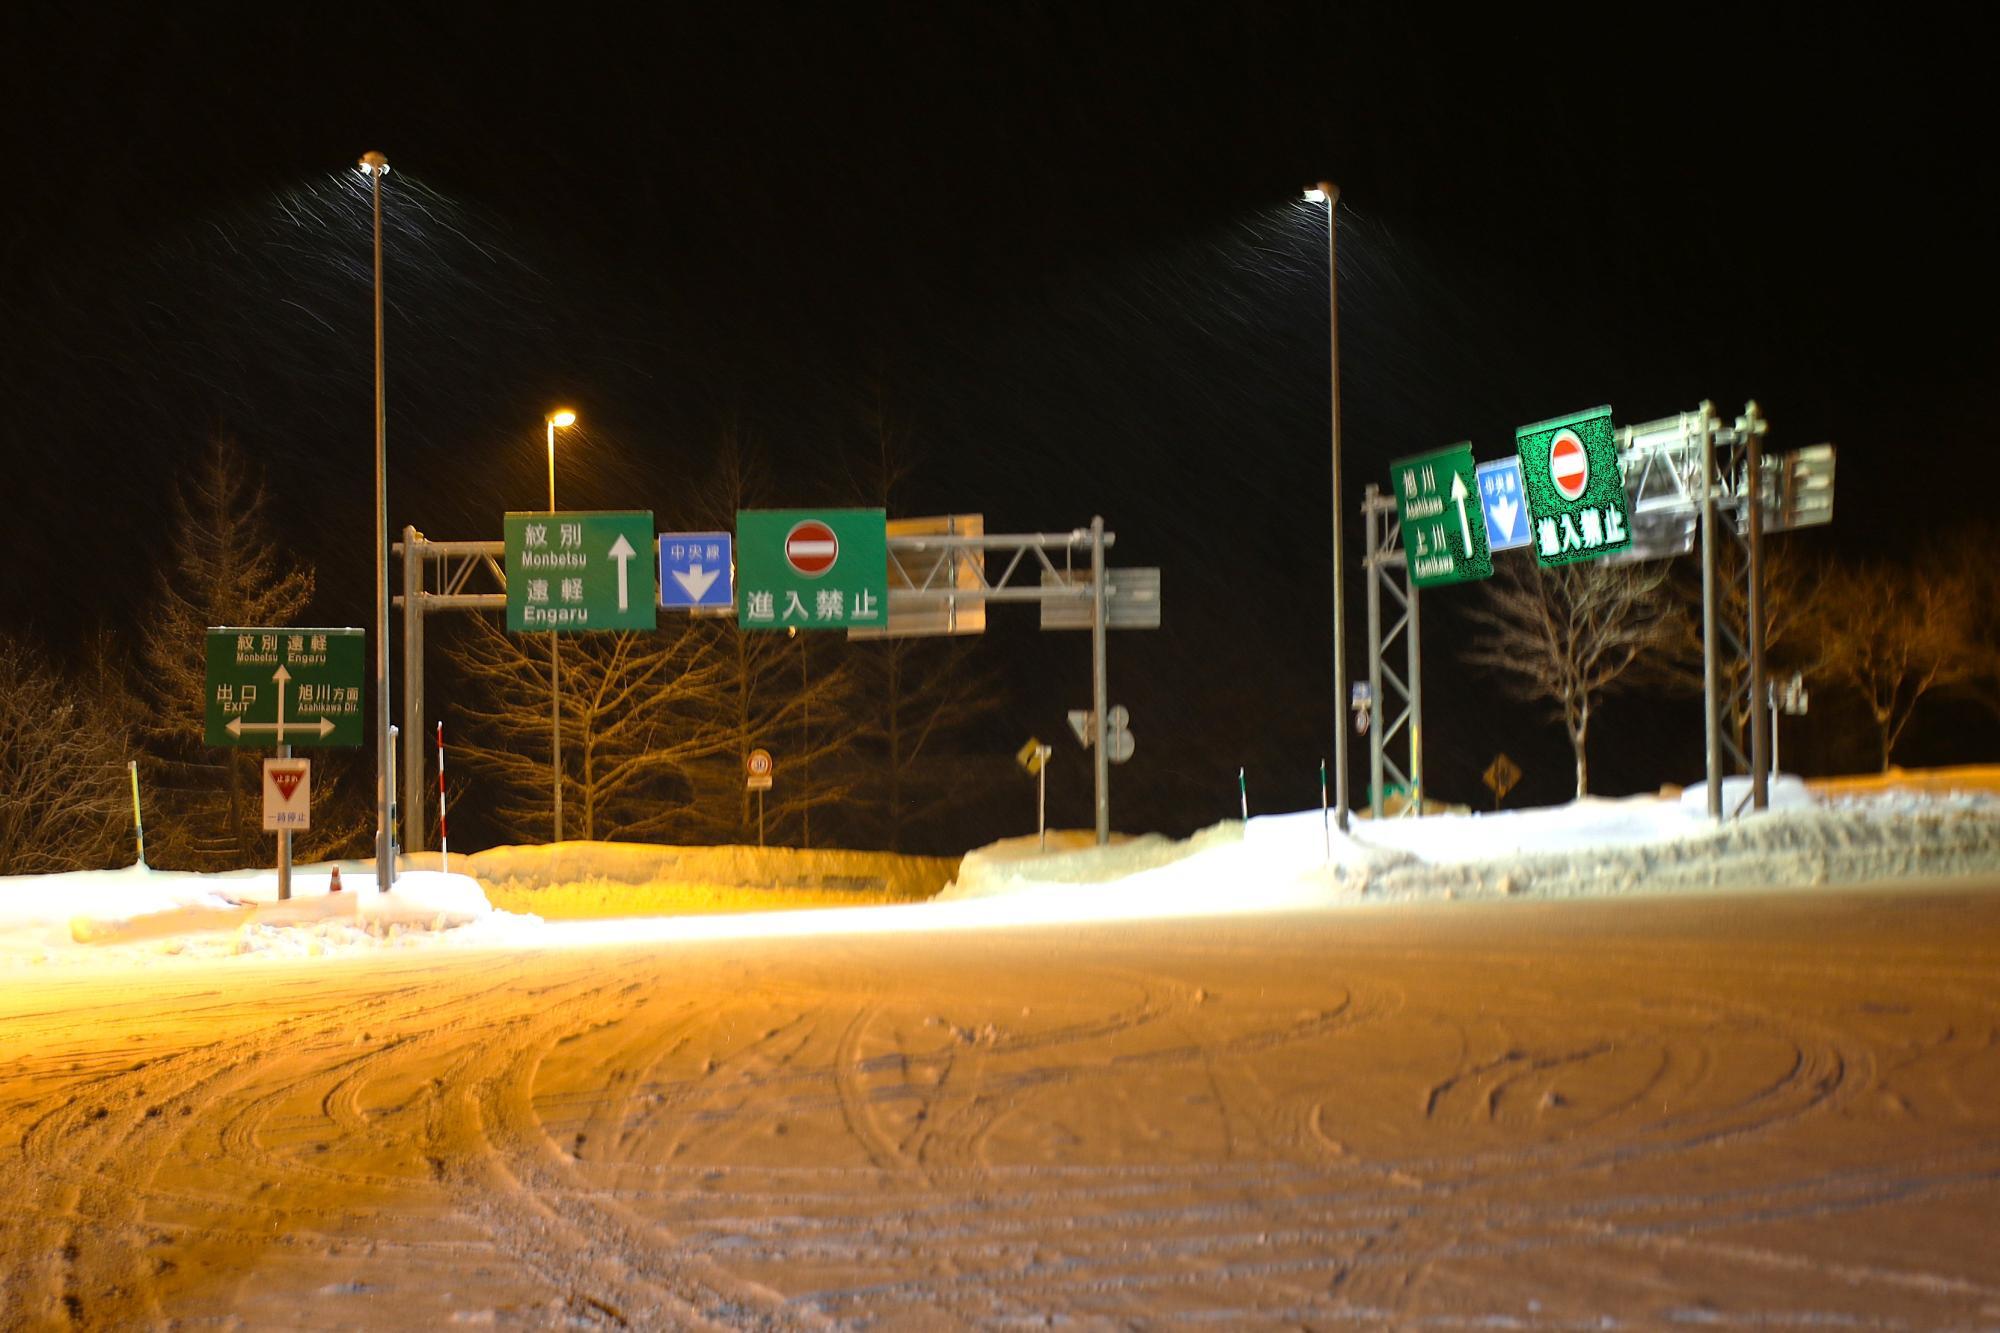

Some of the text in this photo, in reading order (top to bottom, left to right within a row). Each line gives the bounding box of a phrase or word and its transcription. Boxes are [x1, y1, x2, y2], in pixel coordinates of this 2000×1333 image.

[525, 523, 582, 547] 紋別
[522, 551, 587, 567] Monbetsu
[671, 544, 720, 561] 中央線
[527, 578, 583, 604] 遠軽
[747, 588, 878, 621] 進入禁止
[524, 605, 588, 626] Engaru
[236, 634, 327, 652] 紋別 遠軽
[236, 652, 326, 664] Monbetsu Engaru
[216, 683, 257, 702] 出口
[298, 683, 359, 702] 旭川方面
[223, 702, 250, 713] EXIT
[298, 702, 342, 713] Asahikawa
